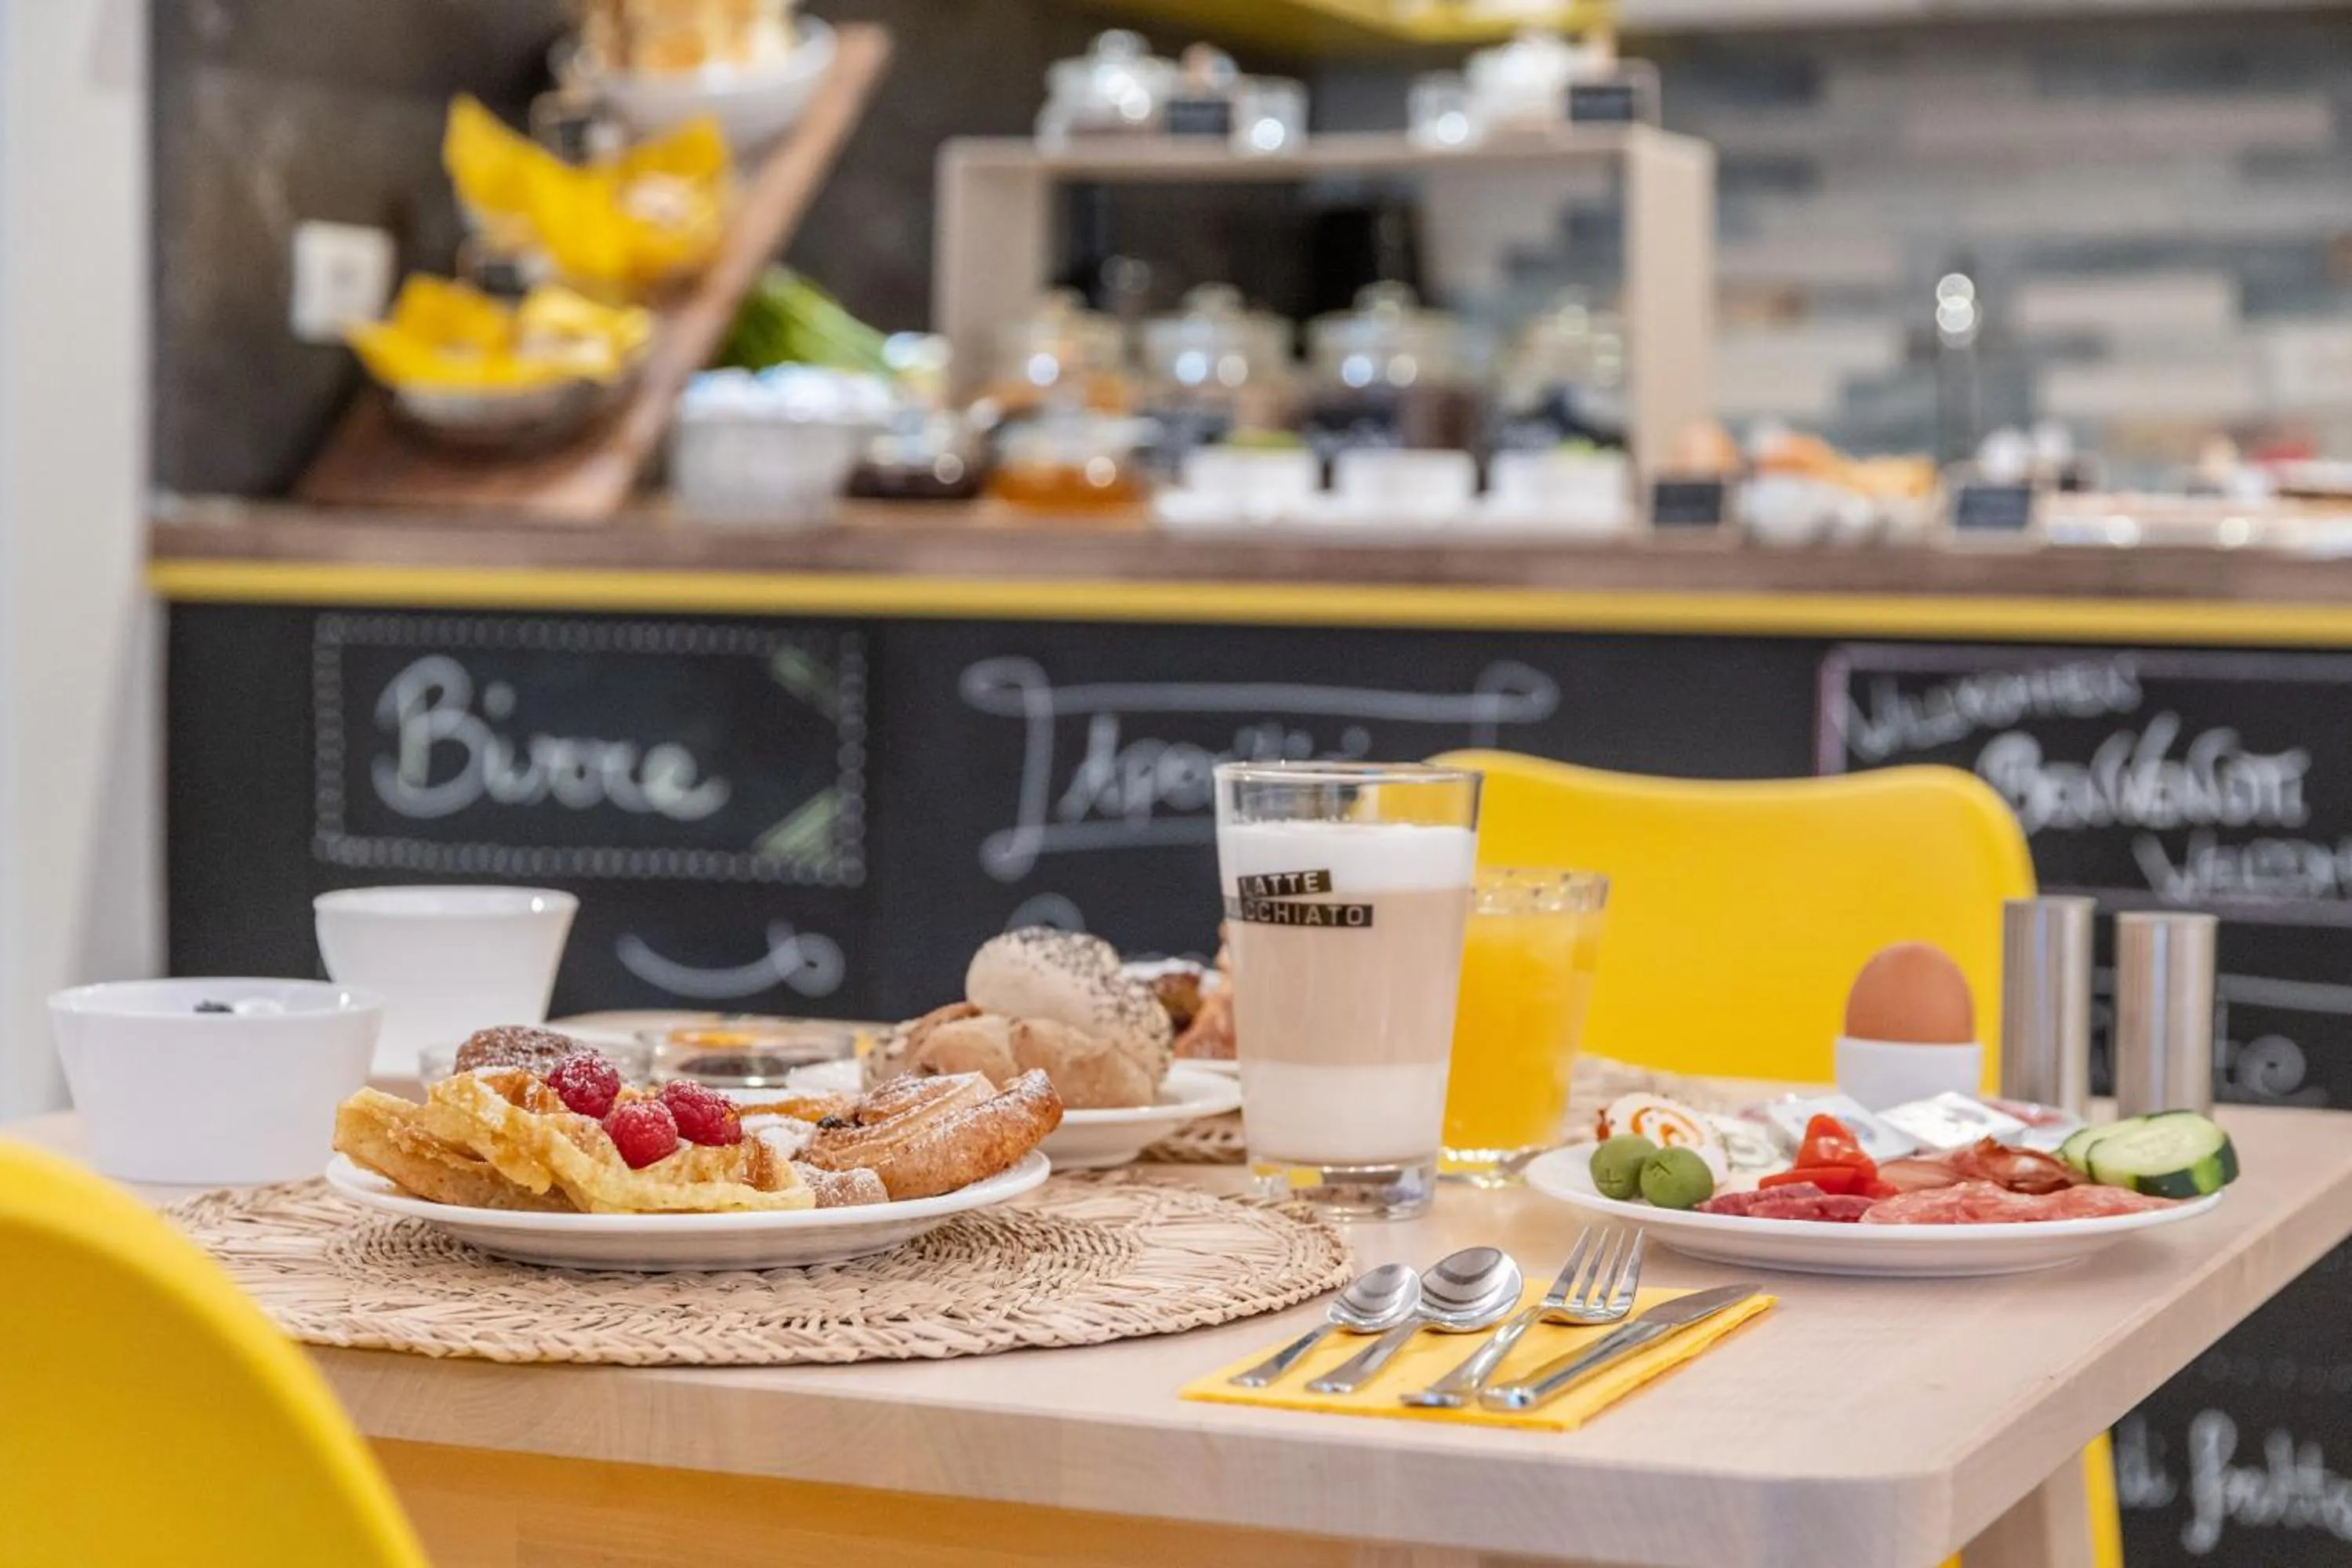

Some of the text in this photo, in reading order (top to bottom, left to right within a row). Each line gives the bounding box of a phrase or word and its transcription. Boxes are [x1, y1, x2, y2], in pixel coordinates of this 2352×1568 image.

[371, 655, 731, 819] Birre
[1240, 871, 1321, 898] LATTE
[1243, 901, 1366, 927] CCHIATO
